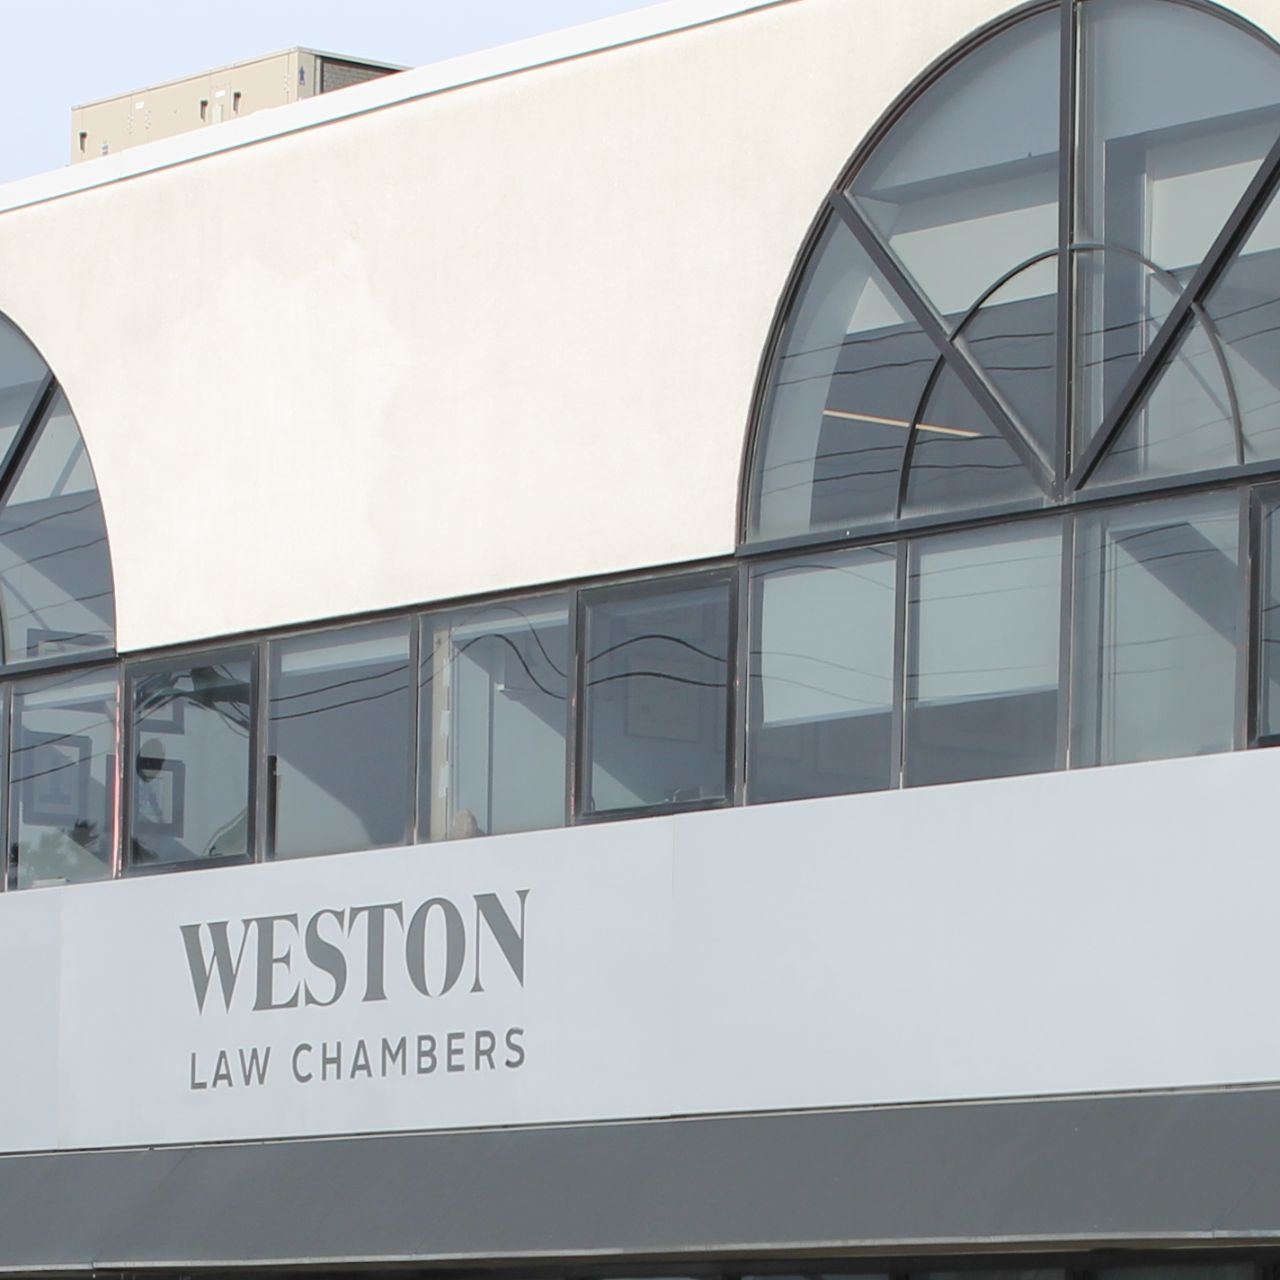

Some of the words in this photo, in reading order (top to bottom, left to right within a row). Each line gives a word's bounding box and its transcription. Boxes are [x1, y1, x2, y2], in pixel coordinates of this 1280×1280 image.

[178, 889, 531, 1015] WESTON
[190, 1046, 271, 1090] LAW
[292, 1027, 526, 1083] CHAMBERS
